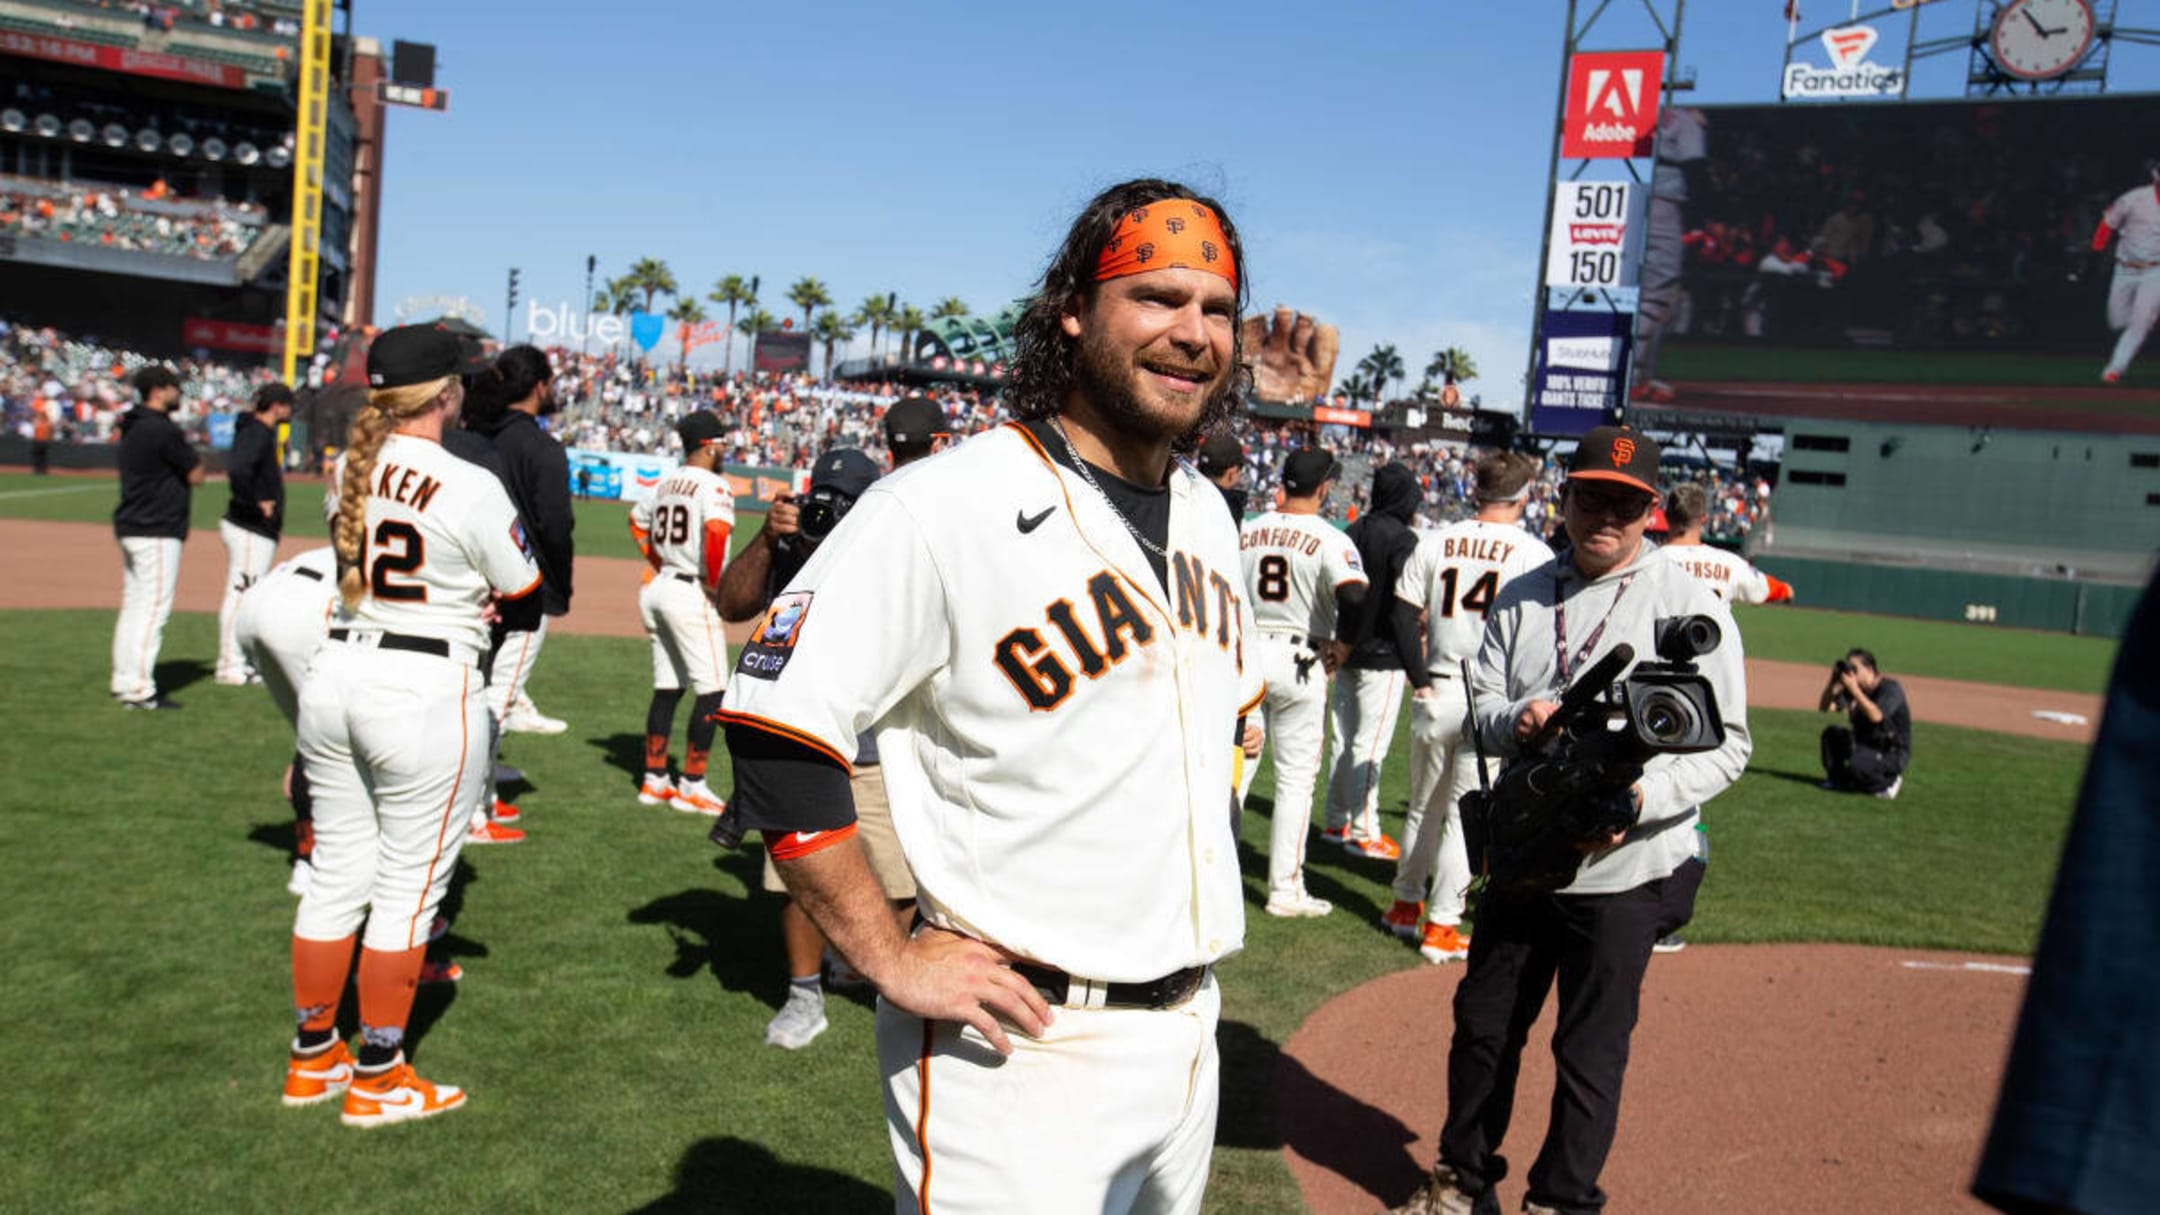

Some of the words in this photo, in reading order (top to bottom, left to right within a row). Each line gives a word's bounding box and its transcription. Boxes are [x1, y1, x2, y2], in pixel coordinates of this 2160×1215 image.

[1789, 68, 1900, 91] Fanatics
[1582, 122, 1636, 142] Adobe
[1576, 185, 1625, 218] 501
[1569, 250, 1617, 283] 150
[528, 299, 625, 343] blue
[366, 463, 442, 513] KEN
[654, 504, 689, 545] 39
[1239, 527, 1322, 556] CONFORTO
[1443, 537, 1515, 564] BAILEY
[1258, 554, 1290, 603] 8
[1440, 566, 1500, 622] 14
